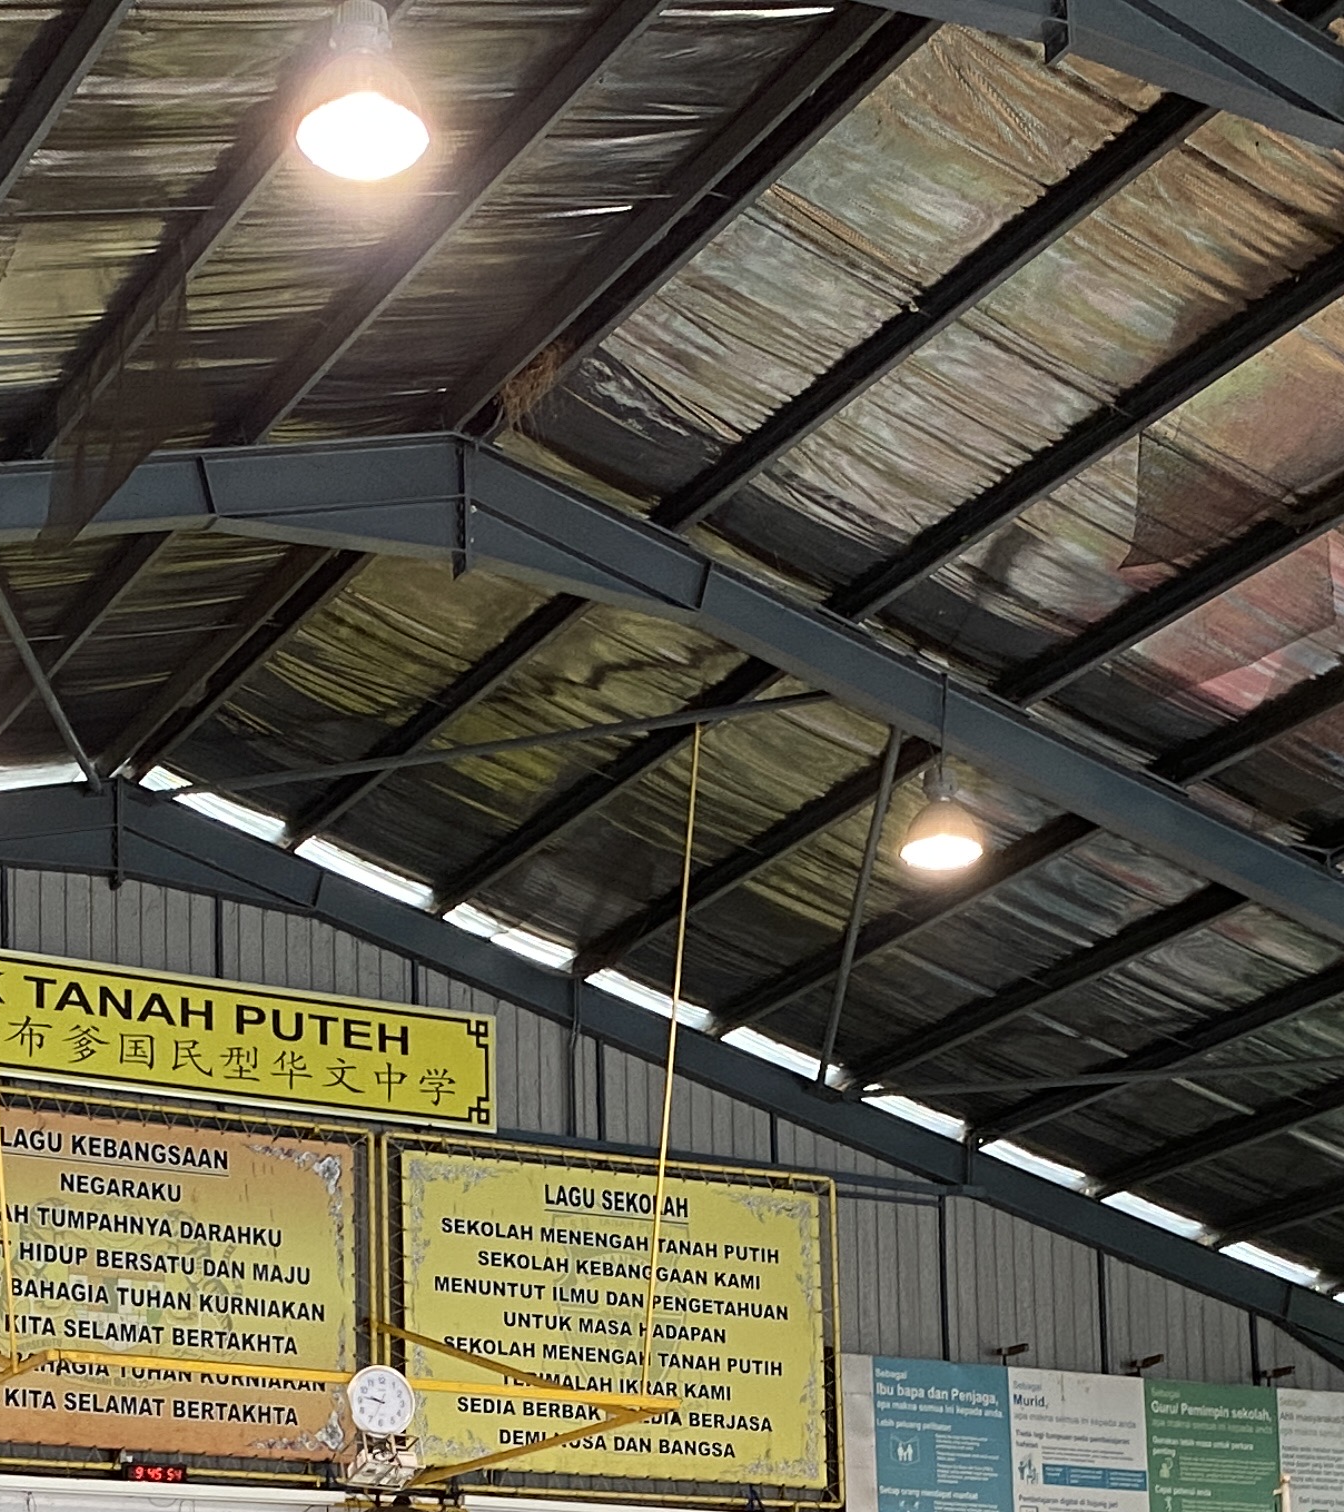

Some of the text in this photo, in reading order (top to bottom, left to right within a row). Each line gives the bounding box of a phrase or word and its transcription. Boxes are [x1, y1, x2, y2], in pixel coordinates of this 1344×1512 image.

[23, 975, 213, 1031] TANAH
[236, 1004, 408, 1055] PUTEH
[0, 1126, 227, 1169] LAGU KEBANGSAAN
[60, 1173, 180, 1202] NEGARAKU
[544, 1183, 594, 1208] LAGU
[37, 1207, 281, 1247] TUMPAHNYA DARAHKU
[441, 1217, 778, 1263] SEKOLAH MENENGAH PUTIH
[19, 1242, 310, 1285] HIDUP BERSATU DAN MAJU
[478, 1250, 760, 1290] SEKOLAH KAMI
[116, 1287, 190, 1310] TUHAN
[199, 1294, 324, 1322] KURNIAKAN
[434, 1275, 643, 1308] MENUNTUT ILMU DAN
[63, 1318, 297, 1354] SELAMAT BERTAKHTA
[503, 1311, 632, 1336] UNTUK MASA
[876, 1382, 998, 1406] Ibu bapa dan Penjaga,
[1013, 1393, 1048, 1408] Murid,
